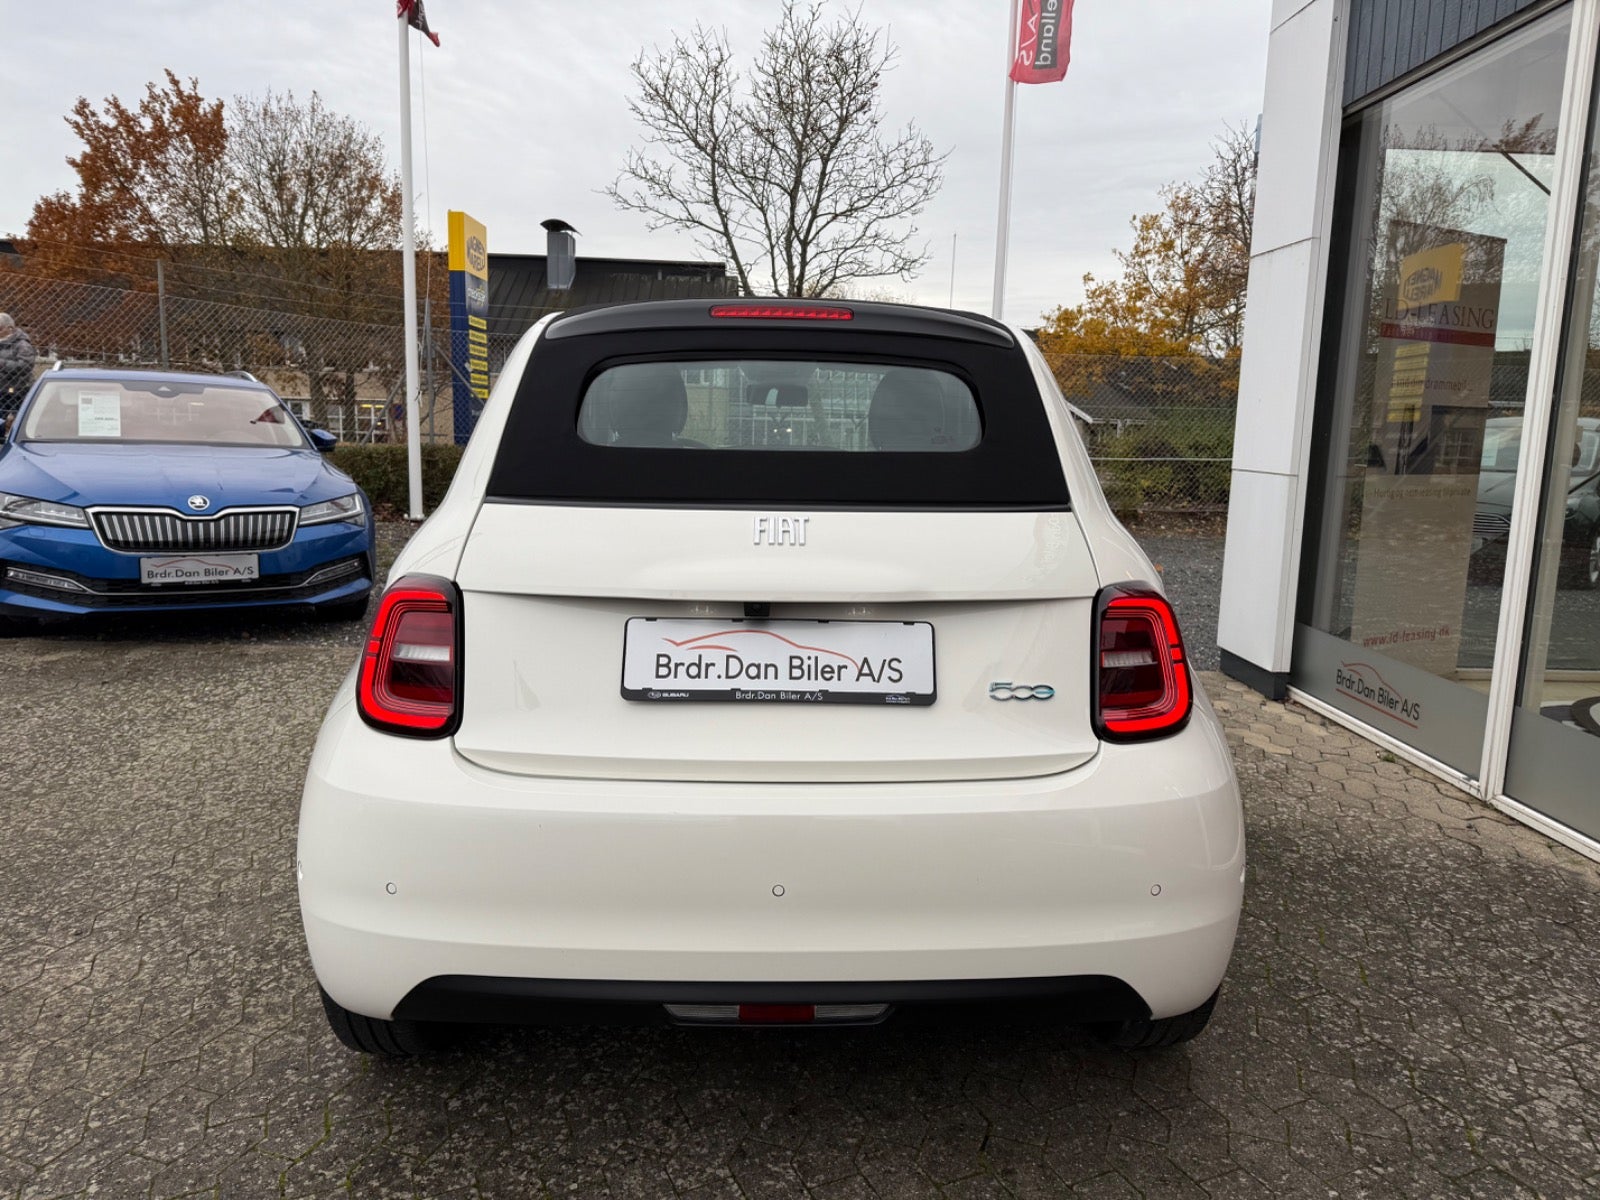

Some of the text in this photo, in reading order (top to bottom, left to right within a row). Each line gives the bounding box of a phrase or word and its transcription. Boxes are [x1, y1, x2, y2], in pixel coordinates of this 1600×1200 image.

[1384, 298, 1495, 329] LD-LEASING
[754, 516, 809, 546] FIAT
[147, 566, 254, 579] Brdr.Dan Biler A/S
[655, 653, 903, 683] Brdr.Dan Biler A/S
[735, 690, 823, 701] Brdr.Dan Biler A/S
[989, 682, 1055, 701] 500
[1336, 669, 1420, 720] Brdr.Dan Biler A/S
